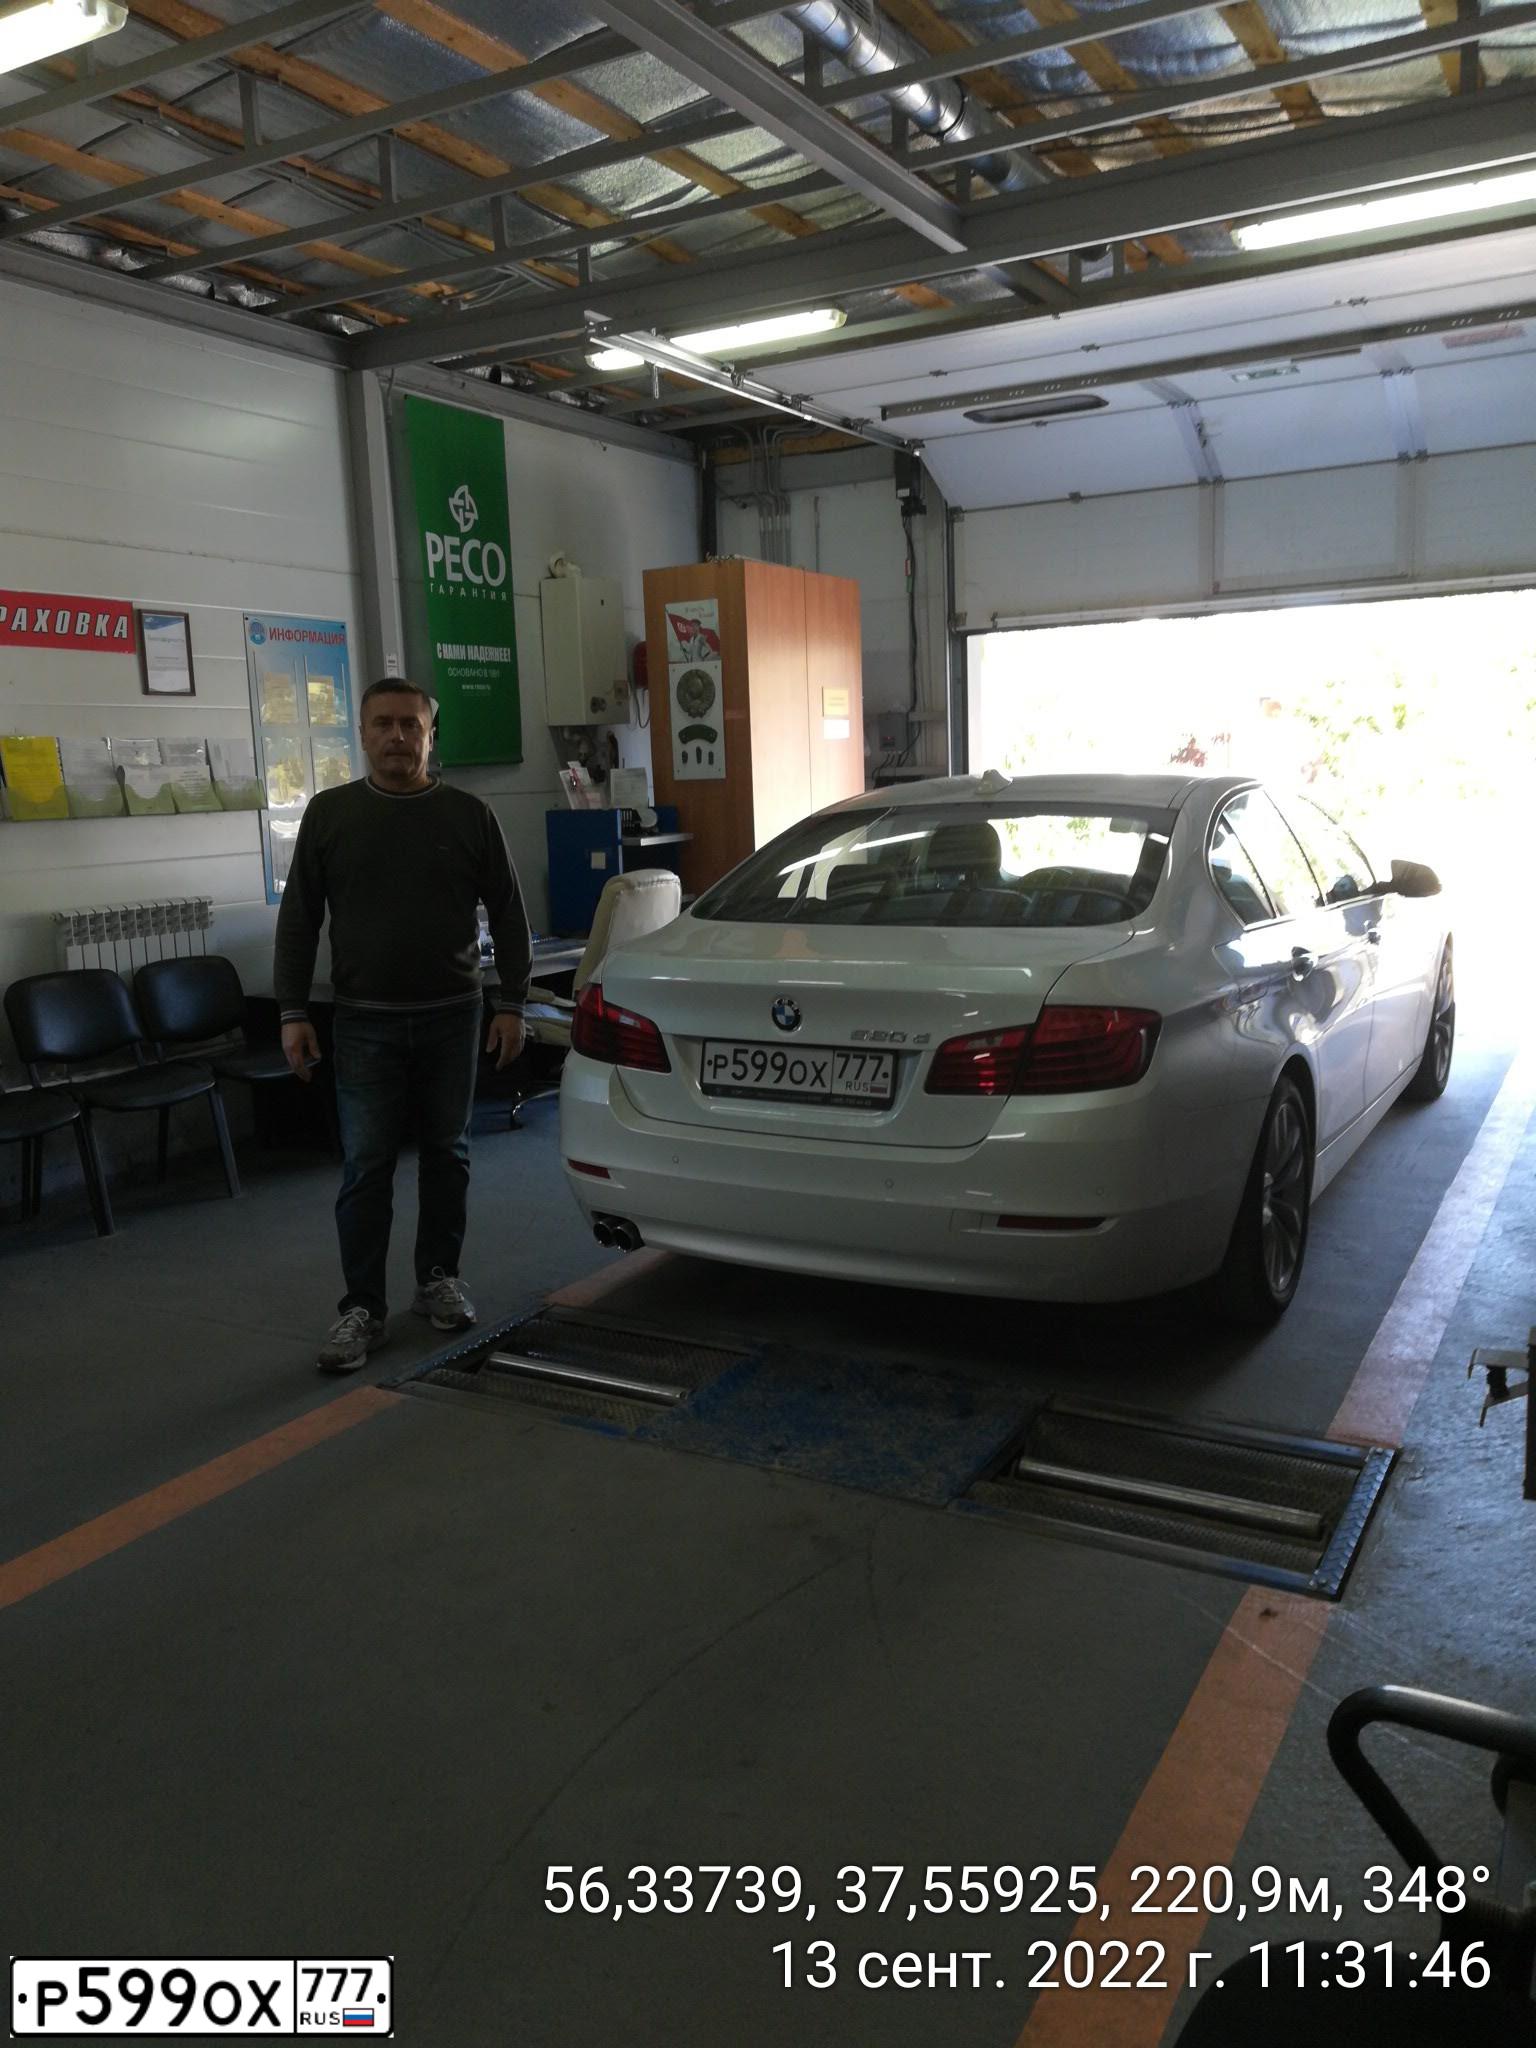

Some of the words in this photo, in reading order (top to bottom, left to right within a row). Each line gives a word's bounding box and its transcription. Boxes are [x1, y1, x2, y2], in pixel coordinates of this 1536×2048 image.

[425, 531, 506, 587] РЕСО
[430, 582, 507, 601] ГАРАНТИЯ
[268, 626, 346, 645] ИНФОРМАЦИЯ
[437, 642, 442, 658] С
[442, 643, 466, 660] НАМИ
[712, 1048, 828, 1088] Р599ОХ
[836, 1053, 884, 1081] 777
[845, 1080, 869, 1093] RUS
